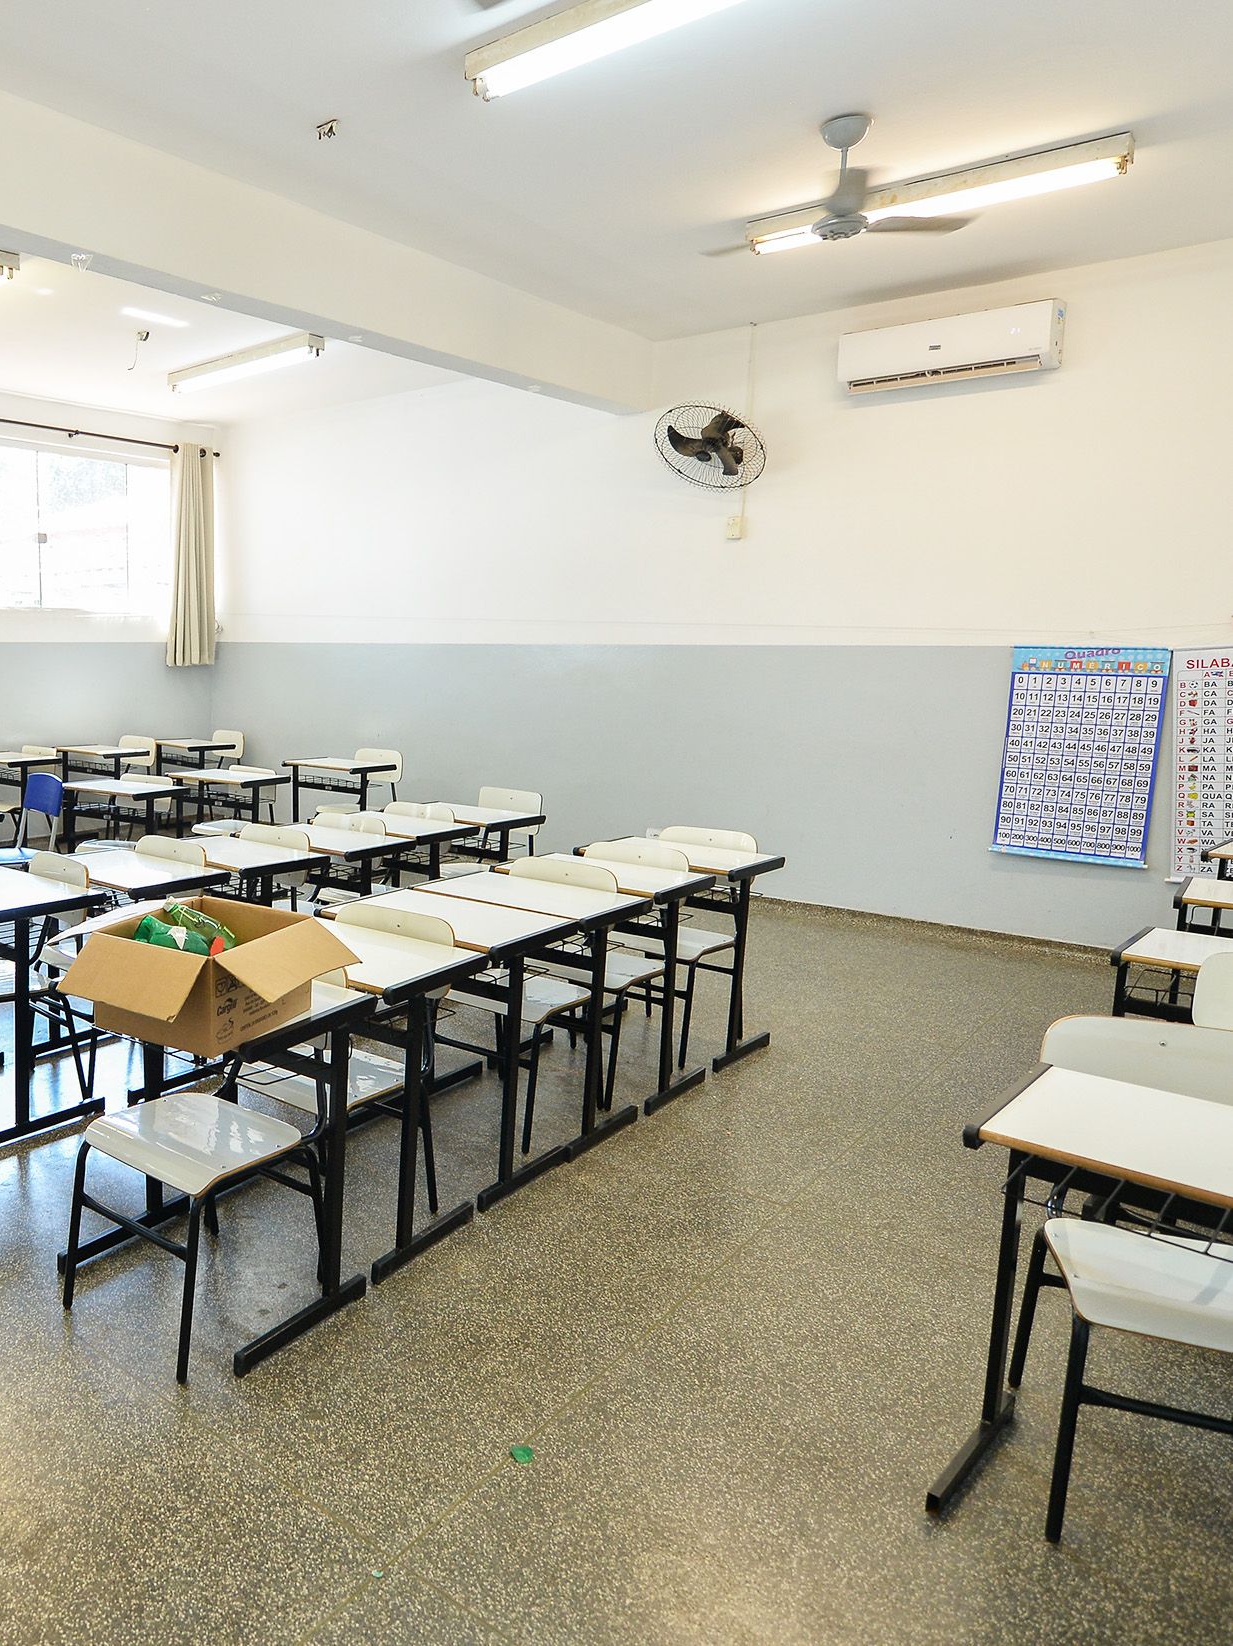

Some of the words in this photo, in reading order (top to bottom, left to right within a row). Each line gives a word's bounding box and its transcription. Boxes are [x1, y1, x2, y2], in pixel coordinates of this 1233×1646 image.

[1064, 648, 1120, 660] Quadro
[1186, 658, 1233, 669] SILAB
[217, 998, 238, 1016] Cargill
